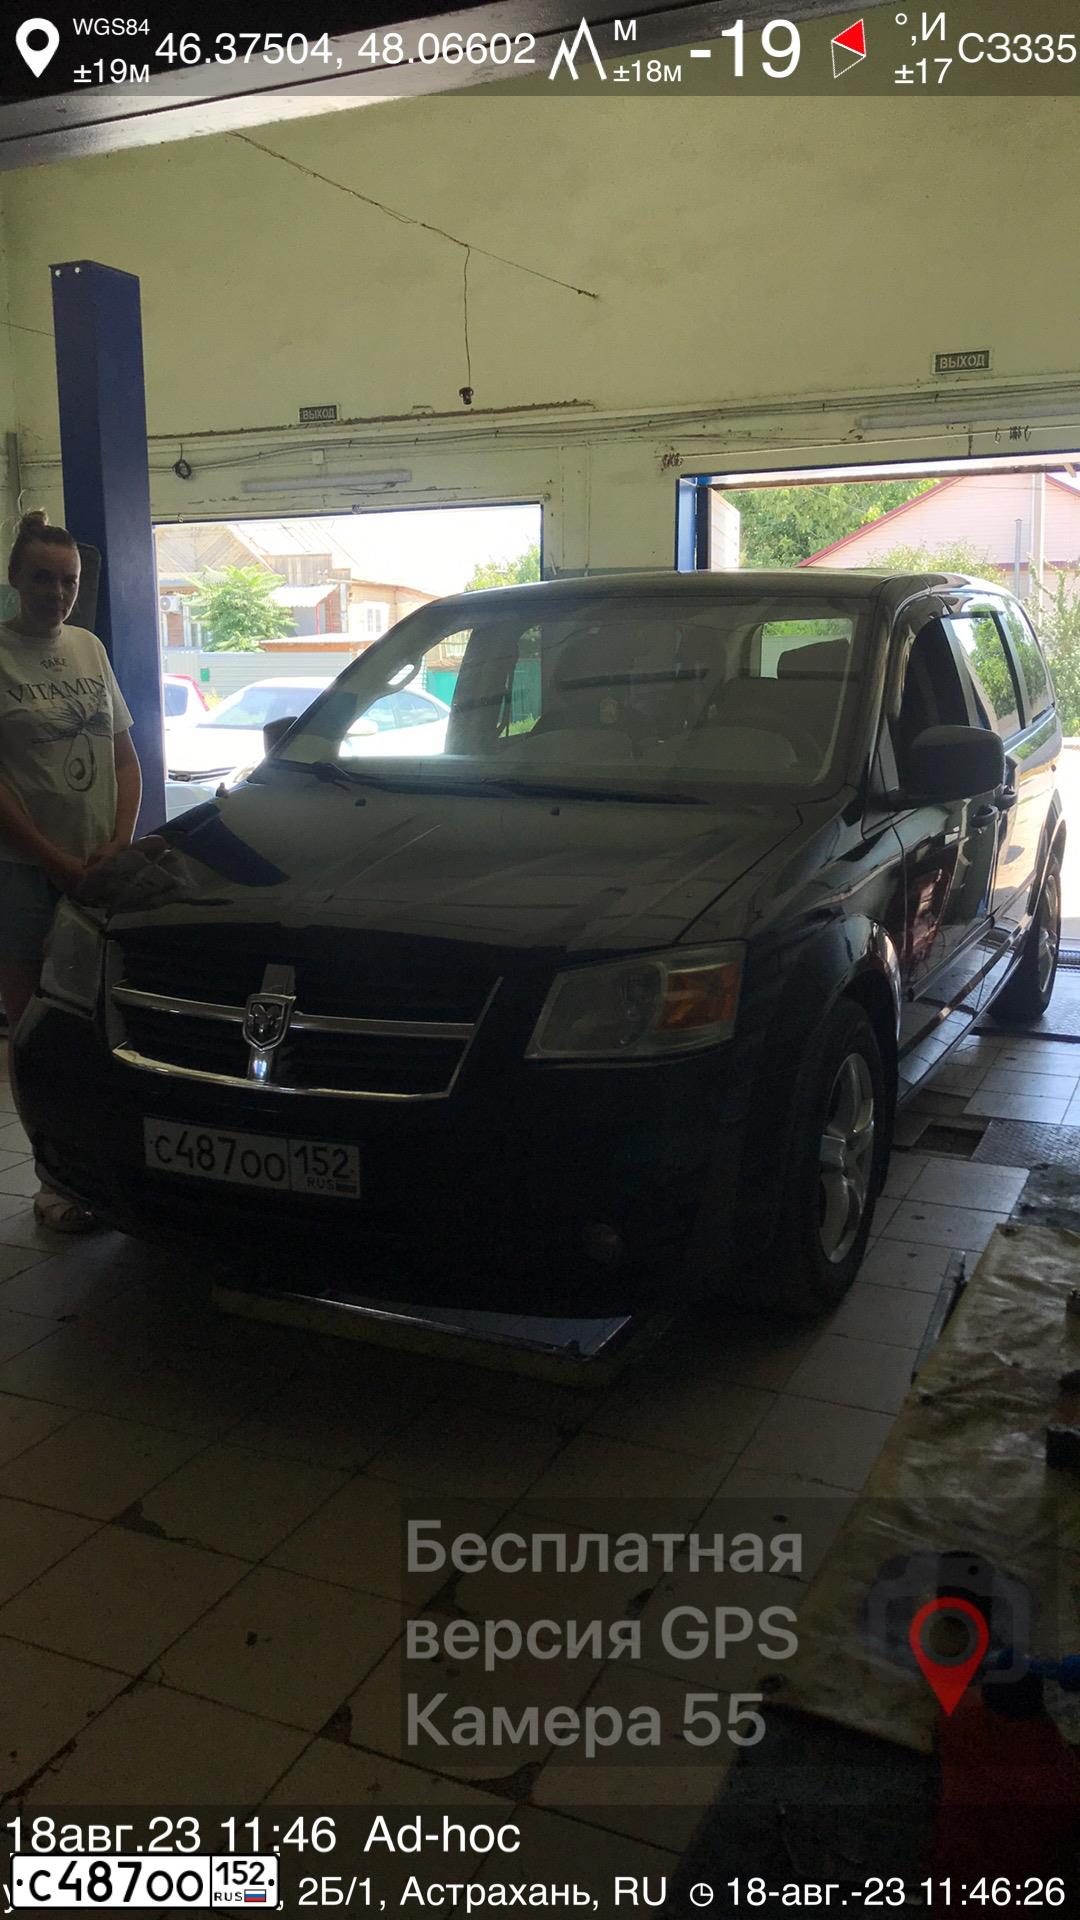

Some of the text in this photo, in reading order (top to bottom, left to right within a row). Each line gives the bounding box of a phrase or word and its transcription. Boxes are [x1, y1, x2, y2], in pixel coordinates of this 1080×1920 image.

[940, 354, 985, 369] ВЫХОД
[302, 407, 336, 420] ВЫХОД
[8, 674, 107, 703] VITAMIN
[294, 1144, 350, 1179] 152
[307, 1176, 337, 1191] RUS
